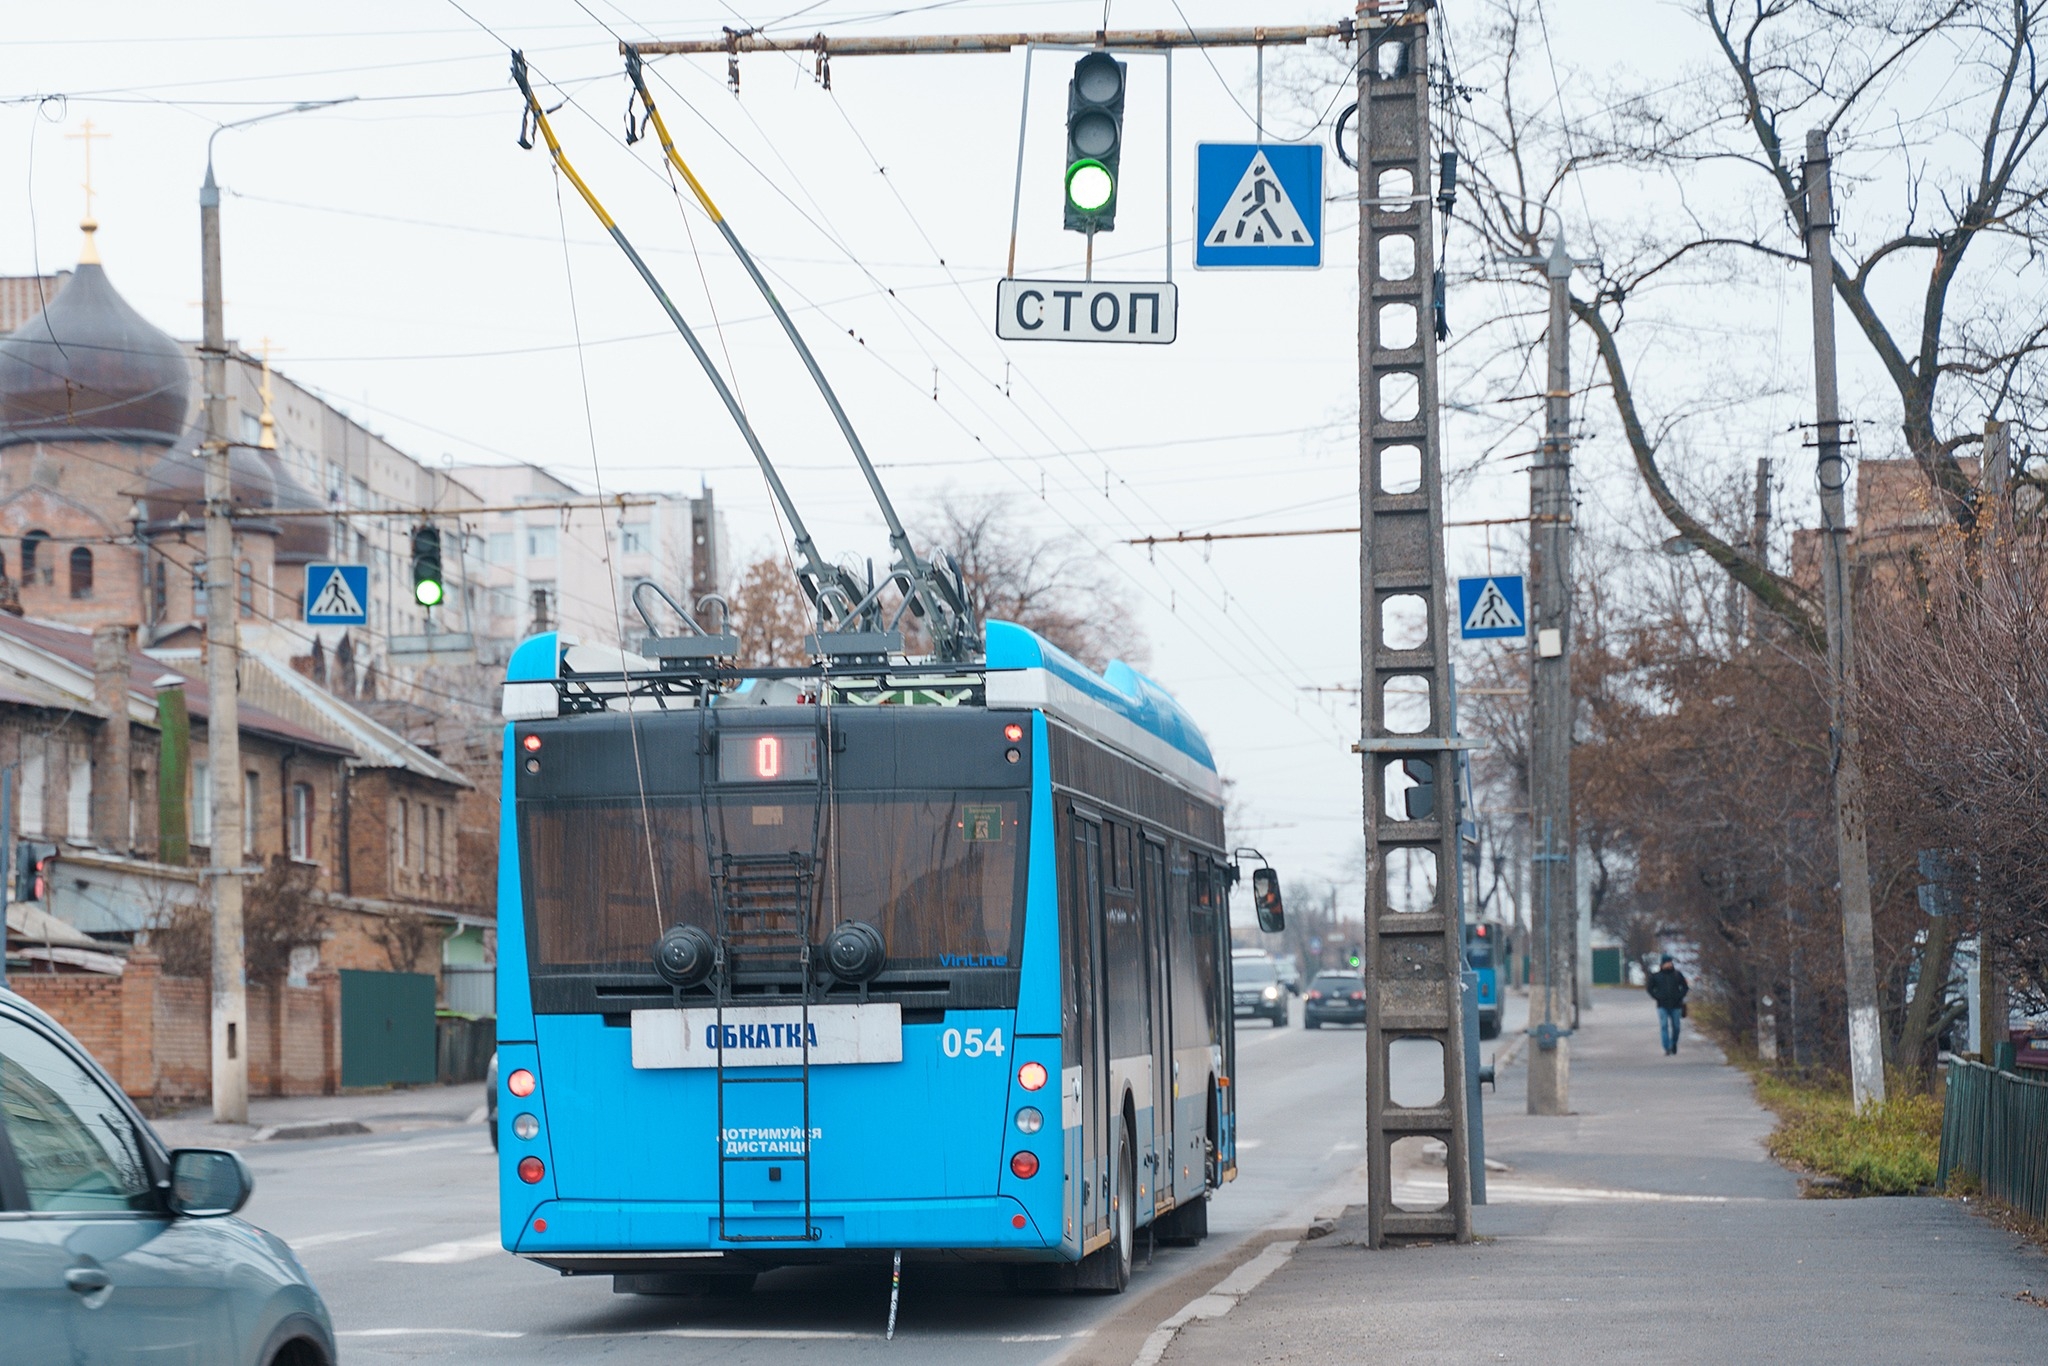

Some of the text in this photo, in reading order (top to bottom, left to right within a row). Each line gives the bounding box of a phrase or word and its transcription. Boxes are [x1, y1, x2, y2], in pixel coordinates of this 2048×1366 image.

[1015, 289, 1160, 334] СТОП
[758, 737, 777, 777] 0
[939, 952, 1008, 968] VinLine
[706, 1023, 818, 1049] ОБКАТКА
[942, 1027, 1005, 1058] 054
[716, 1126, 822, 1142] ДОТРИМУЙСЯ
